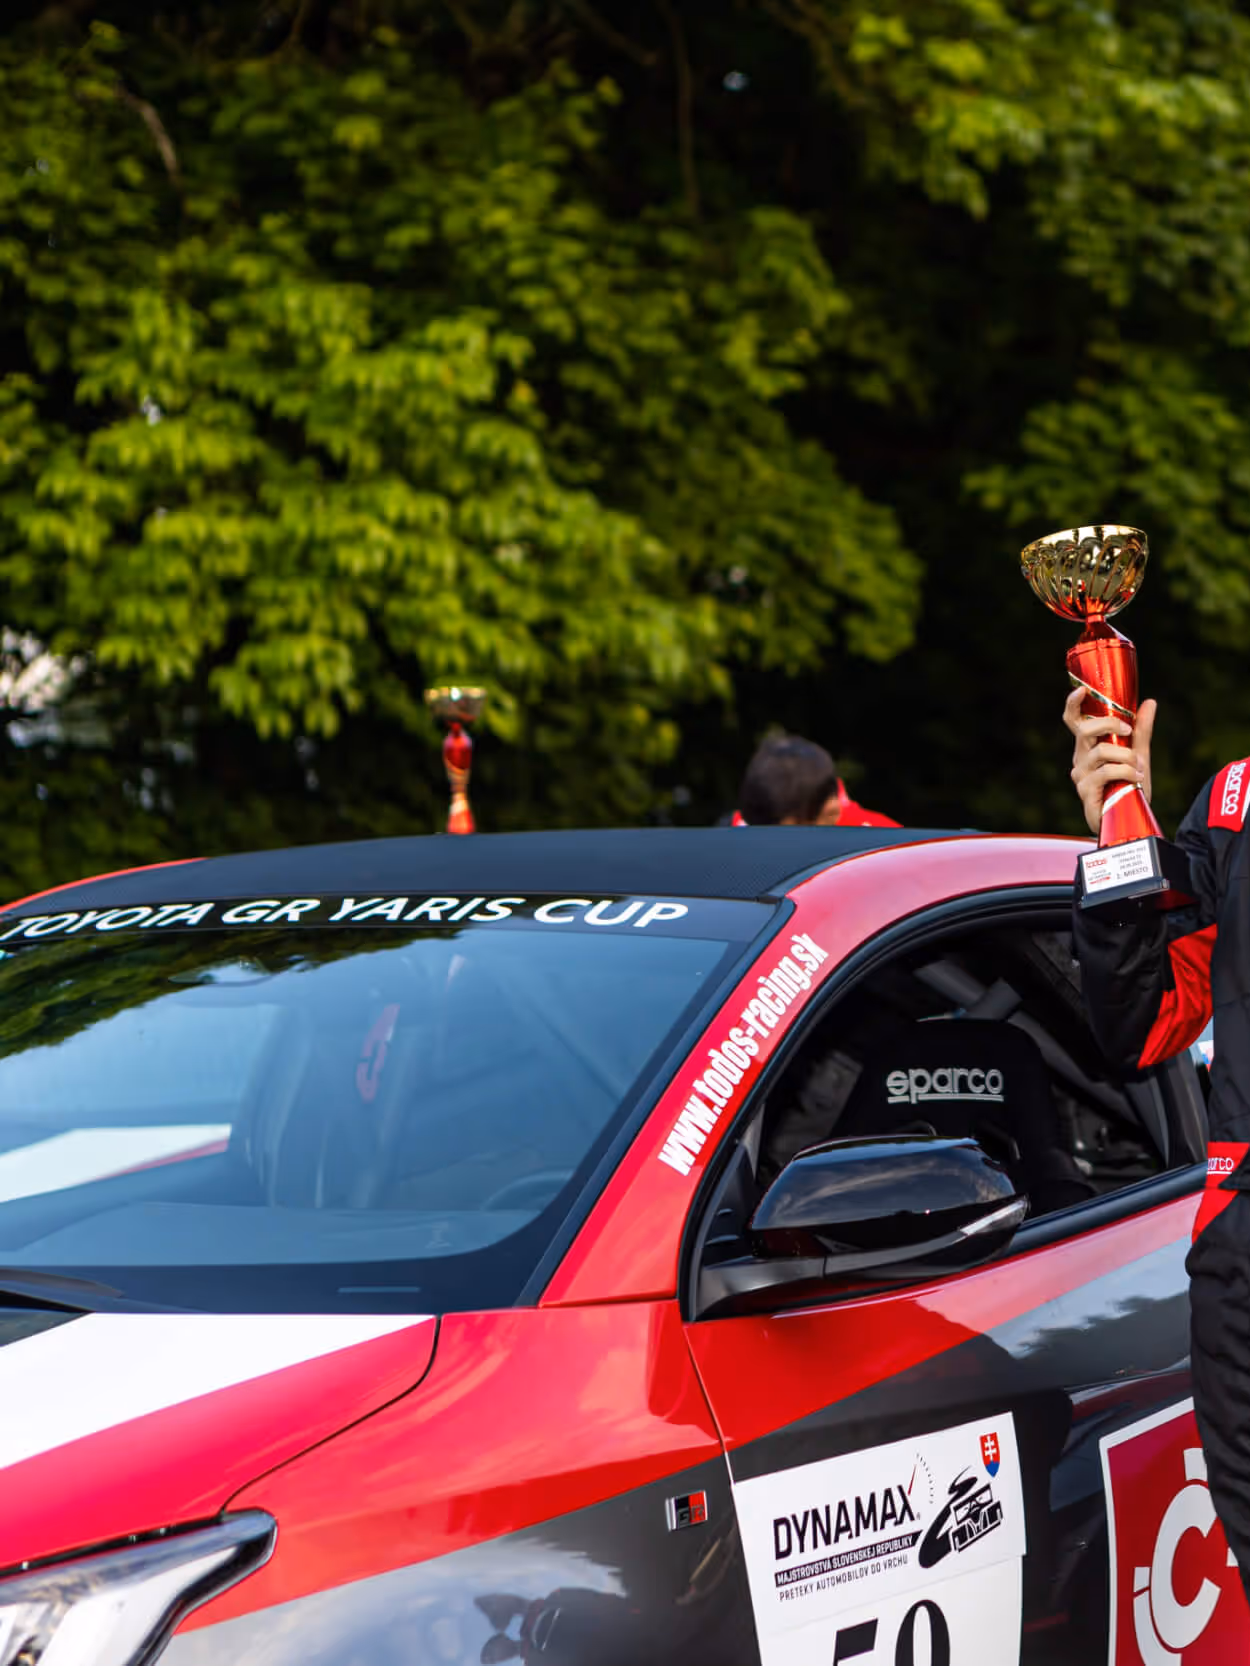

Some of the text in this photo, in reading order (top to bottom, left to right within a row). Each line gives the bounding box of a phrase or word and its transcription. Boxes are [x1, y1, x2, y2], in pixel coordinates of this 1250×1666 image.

[0, 896, 690, 942] TOYOTA GR YARIS CUP
[657, 932, 830, 1177] www.todos-racing.sk
[886, 1067, 1004, 1104] sparco
[773, 1485, 915, 1560] DYNAMAX
[779, 1554, 908, 1602] PRETEKY AUTOMOBILOV DO VRCHU
